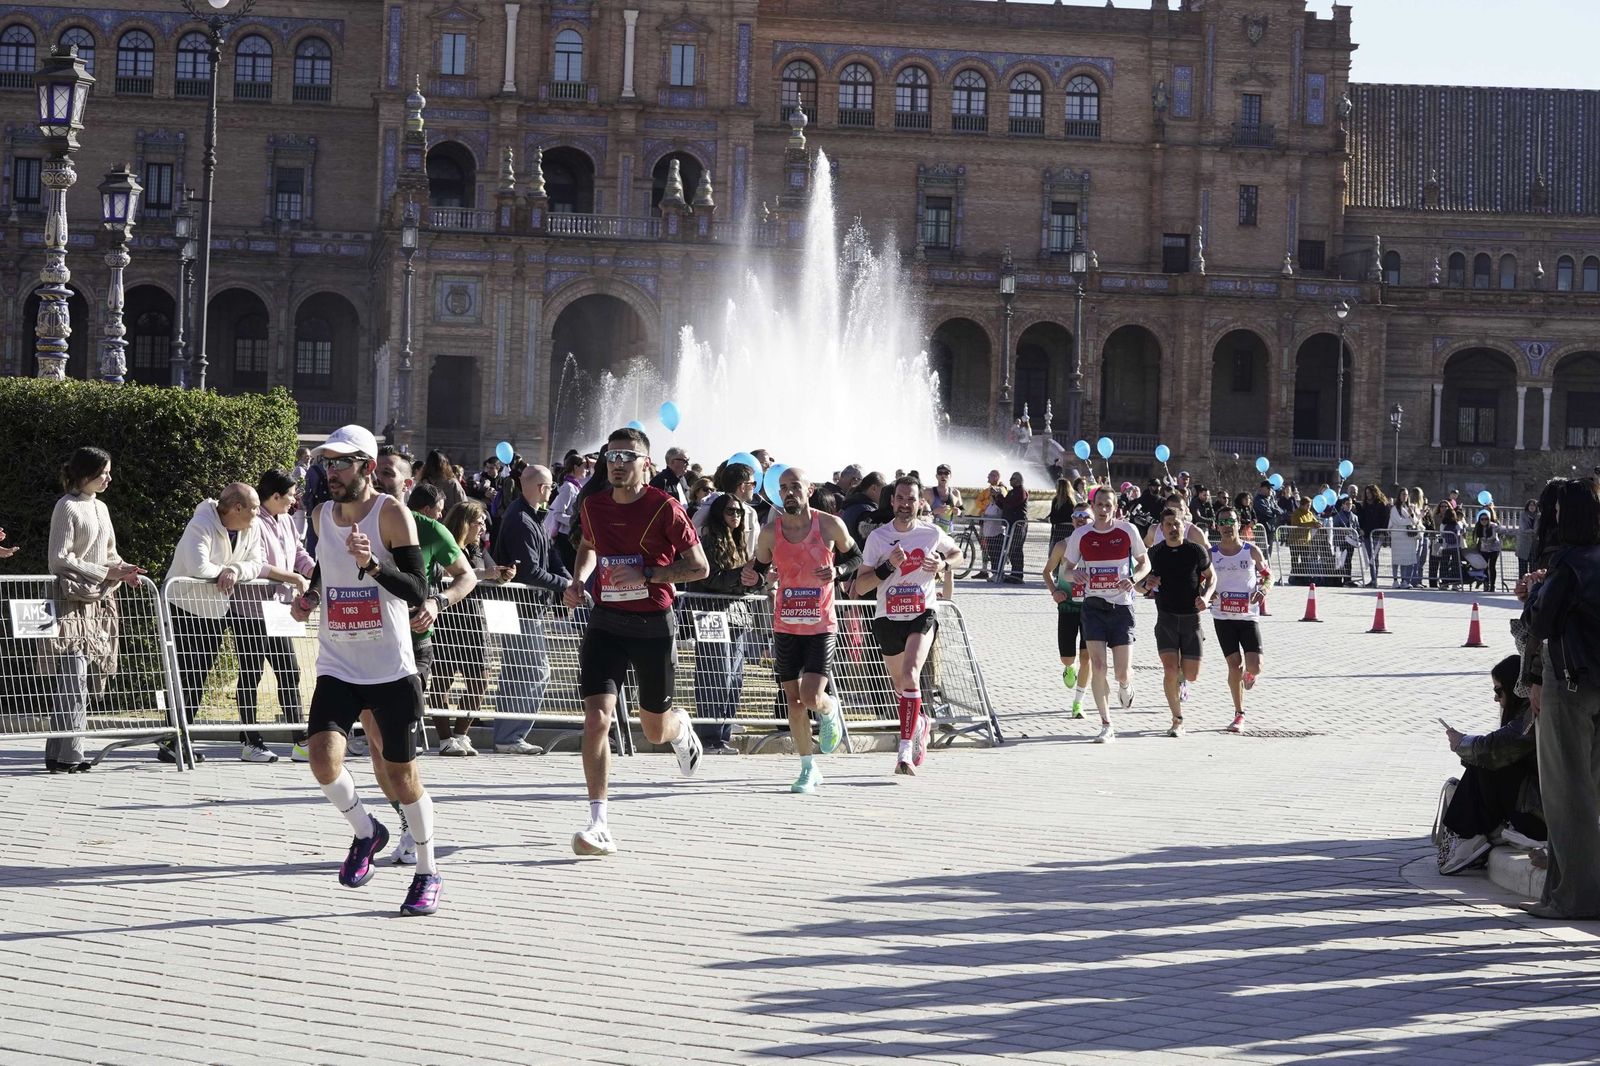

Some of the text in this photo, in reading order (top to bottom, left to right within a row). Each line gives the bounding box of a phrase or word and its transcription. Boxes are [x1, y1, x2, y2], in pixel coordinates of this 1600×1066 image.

[611, 558, 637, 566] ZURICH
[340, 590, 371, 598] ZURICH
[22, 603, 48, 621] AMS
[341, 606, 359, 614] 1063
[781, 608, 821, 617] 50872894E
[891, 603, 921, 613] SÚPER 5
[328, 619, 383, 630] CÉSAR ALMEIDA
